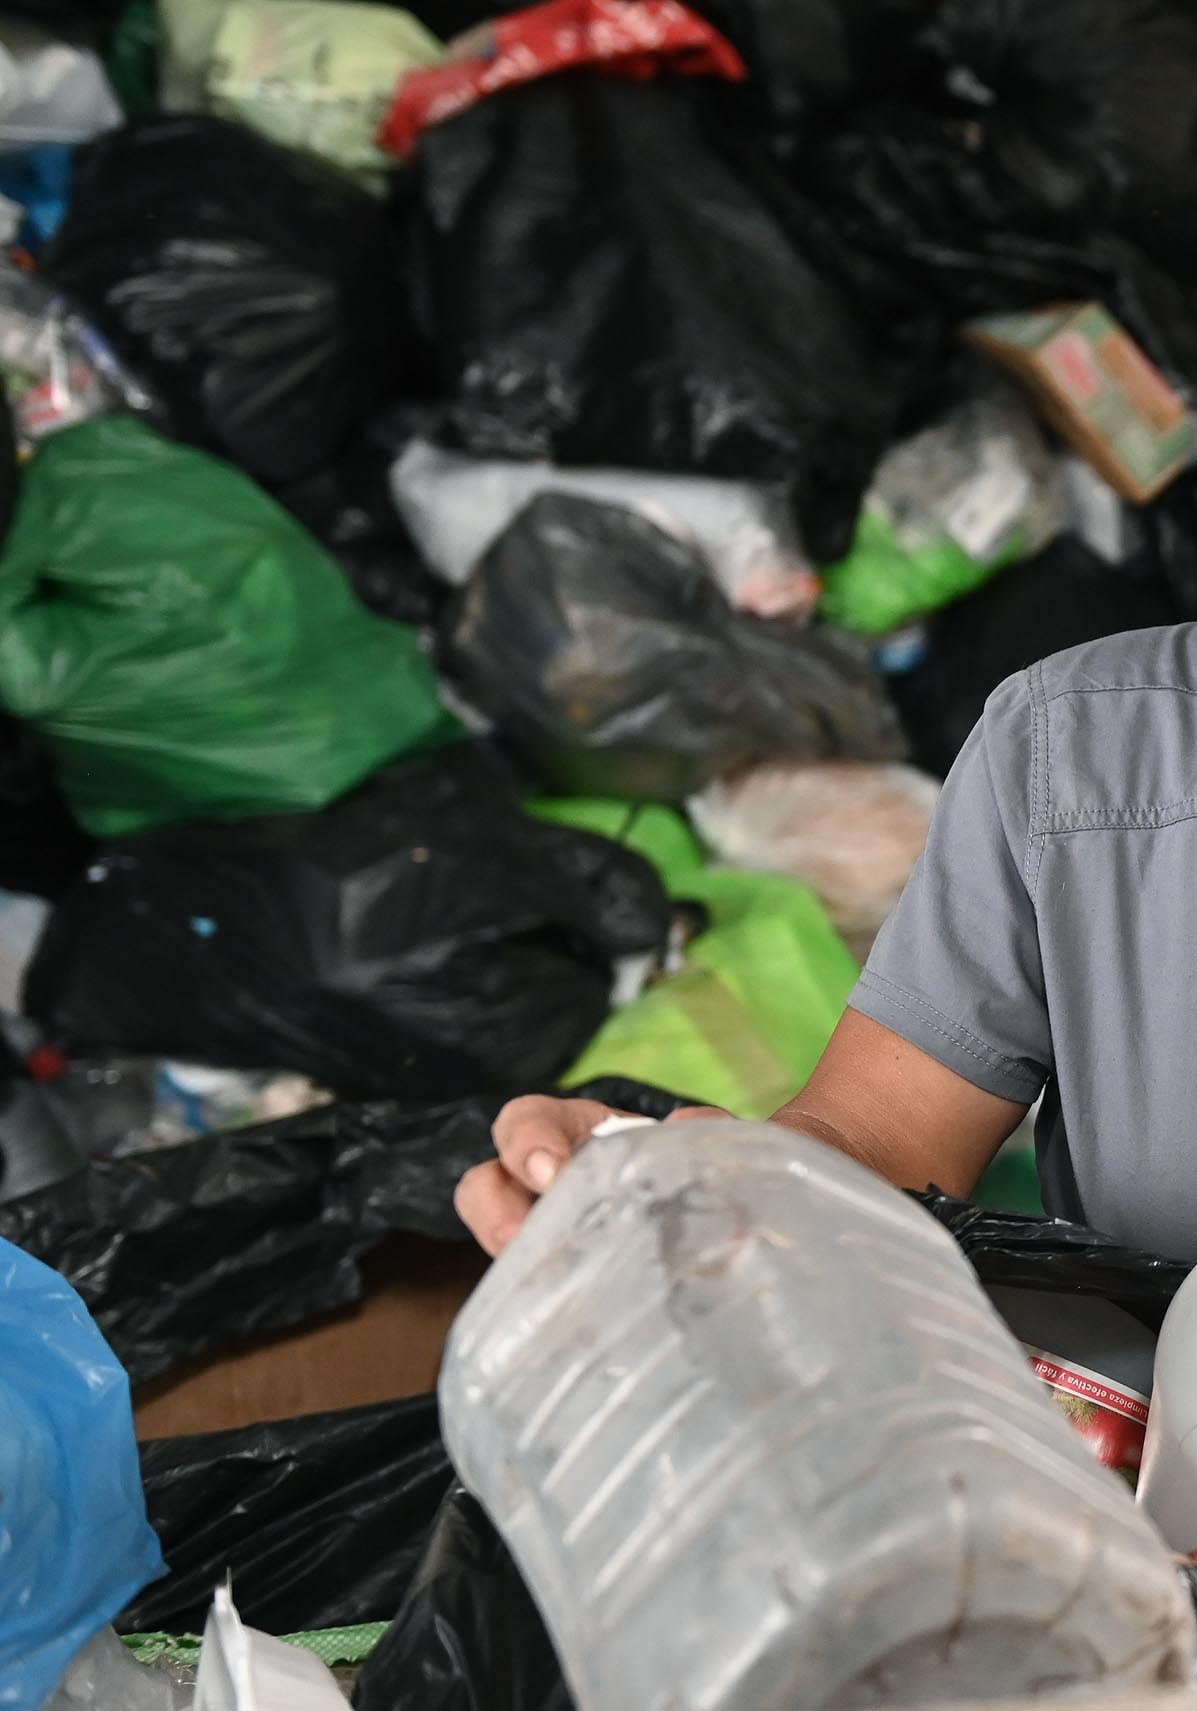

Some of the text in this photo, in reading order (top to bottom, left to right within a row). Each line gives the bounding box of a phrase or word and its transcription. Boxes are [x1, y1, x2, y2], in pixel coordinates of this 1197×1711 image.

[1034, 1362, 1058, 1379] fácil
[1059, 1372, 1067, 1381] y
[1067, 1376, 1107, 1399] efectiva
